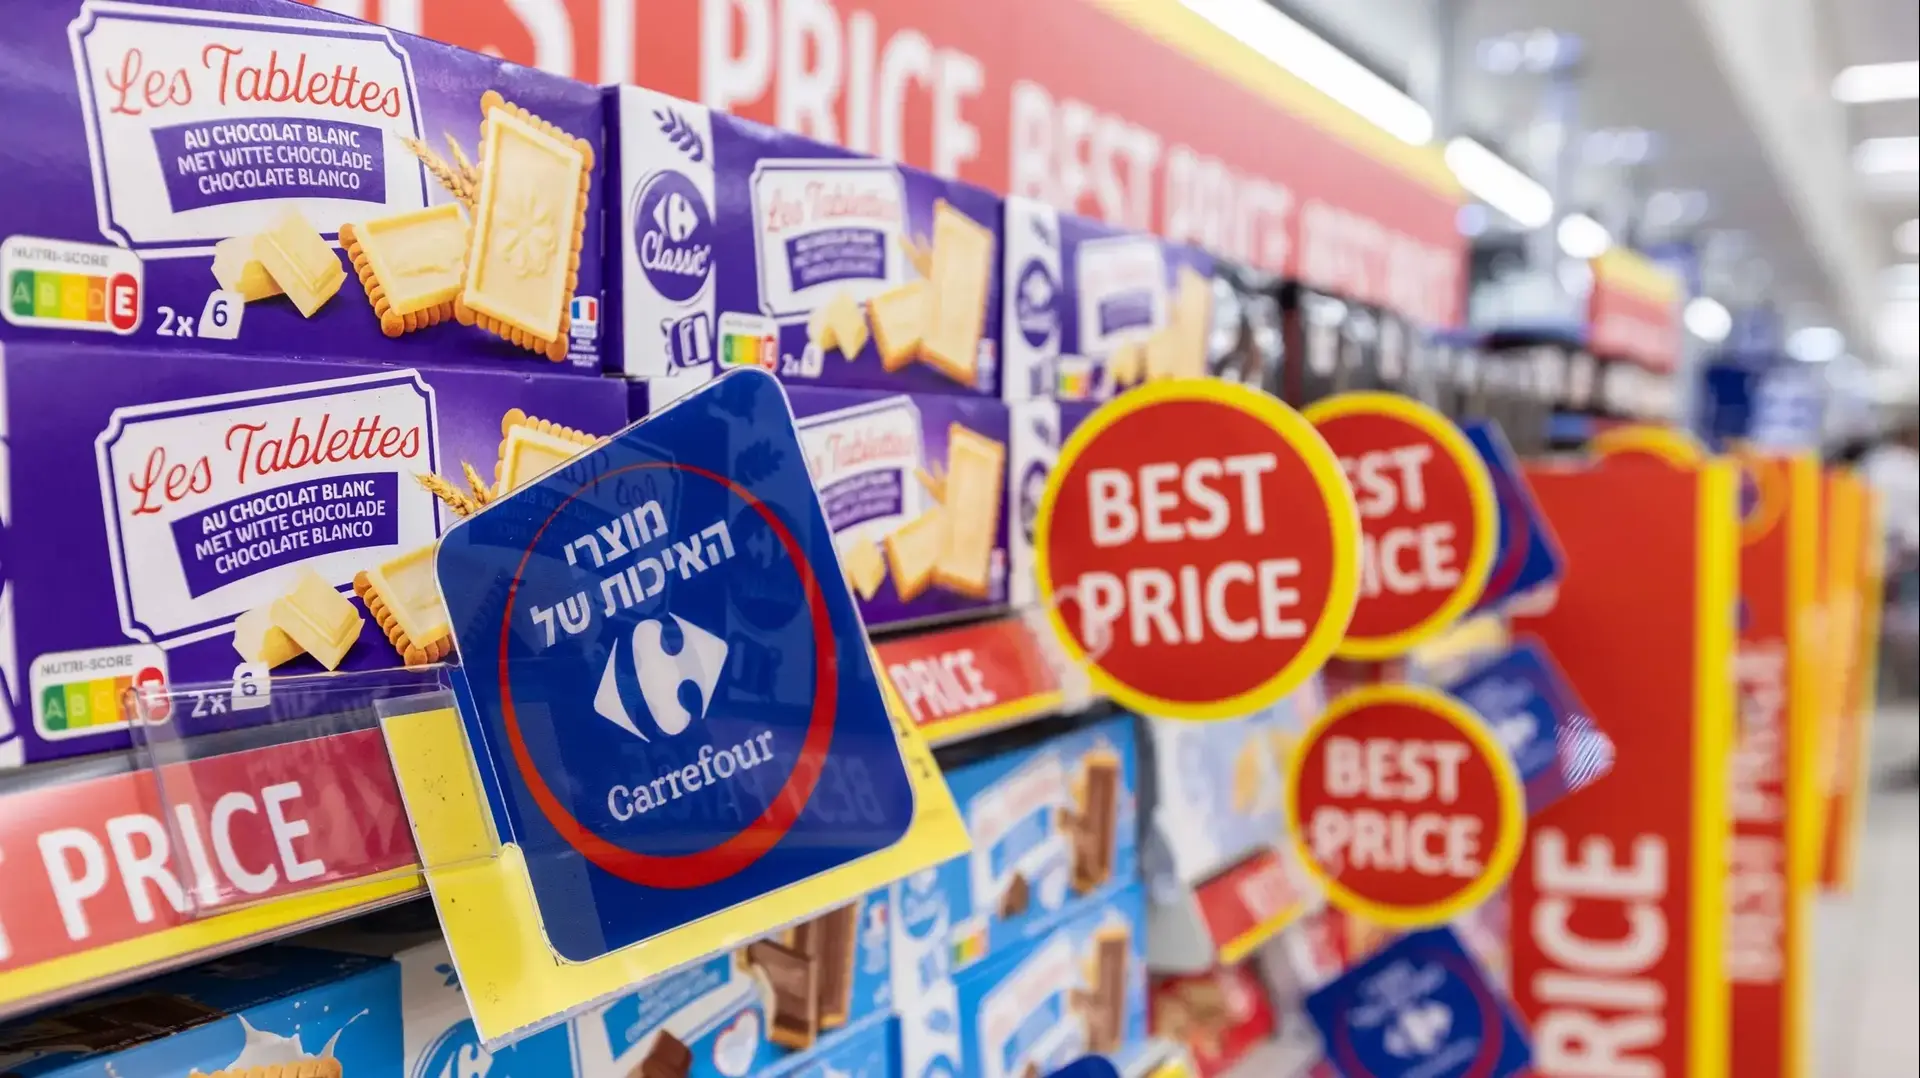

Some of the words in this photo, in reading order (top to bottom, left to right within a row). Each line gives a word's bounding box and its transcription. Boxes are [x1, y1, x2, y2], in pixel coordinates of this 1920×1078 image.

[105, 47, 193, 115] Les
[202, 43, 401, 118] Tablettes
[706, 0, 984, 186] PRICE
[177, 151, 216, 174] MET
[219, 146, 274, 168] WITTE
[276, 145, 373, 172] CHOCOLADE
[184, 130, 210, 150] AU
[212, 123, 302, 146] CHOCOLAT
[308, 126, 360, 148] BLANC
[198, 168, 296, 195] CHOCOLATE
[298, 168, 360, 190] BLANCO
[12, 246, 110, 267] NUTRI-SCORE
[641, 230, 712, 277] Classic
[114, 286, 136, 317] E
[156, 305, 194, 337] 2x
[212, 299, 228, 327] 6
[128, 447, 212, 516] Les
[225, 413, 420, 484] Tablettes
[1343, 443, 1435, 517] ST
[195, 534, 234, 561] MET
[234, 515, 289, 548] WITTE
[291, 500, 386, 528] CHOCOLADE
[202, 511, 227, 535] AU
[229, 485, 318, 523] CHOCOLAT
[322, 479, 376, 502] BLANC
[563, 500, 669, 568] מוצרי
[1086, 453, 1277, 548] BEST
[215, 535, 309, 574] CHOCOLATE
[312, 520, 373, 548] BLANCO
[600, 519, 736, 618] האיכות
[1359, 521, 1463, 598] ICE
[529, 591, 591, 648] של
[1077, 557, 1306, 648] PRICE
[40, 654, 134, 677] NUTRI-SCORE
[888, 648, 998, 722] PRICE
[188, 690, 228, 718] 2x
[607, 730, 774, 822] Carrefour
[1323, 736, 1470, 804] BEST
[37, 781, 326, 941] PRICE
[1310, 806, 1485, 878] PRICE
[1531, 825, 1669, 1078] RICE
